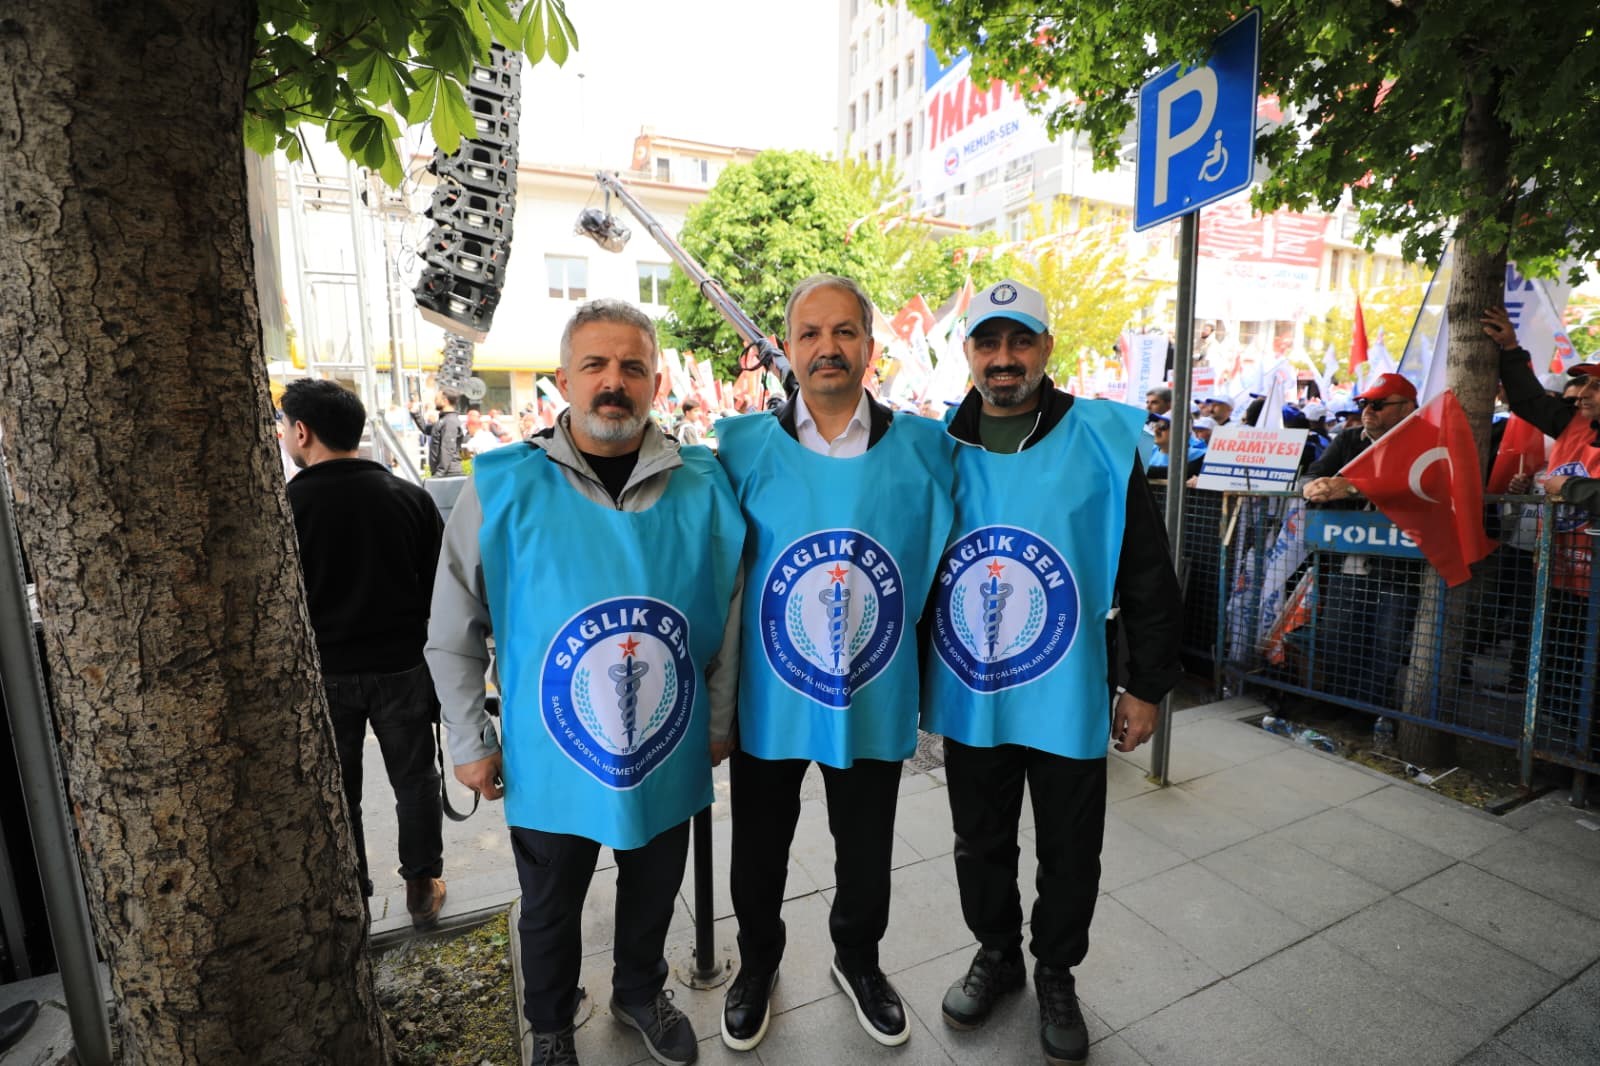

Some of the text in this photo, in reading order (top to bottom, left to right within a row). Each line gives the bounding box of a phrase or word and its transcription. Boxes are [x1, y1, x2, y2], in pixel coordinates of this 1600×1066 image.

[963, 119, 1020, 155] MEMUR-SEN
[1152, 65, 1218, 208] P
[772, 538, 897, 597] SAĞLIK SEN
[939, 535, 1065, 590] SAĞLIK SEN
[555, 607, 687, 670] SAĞLIK SEN
[564, 727, 576, 740] VE
[573, 738, 601, 767] SOSYAL
